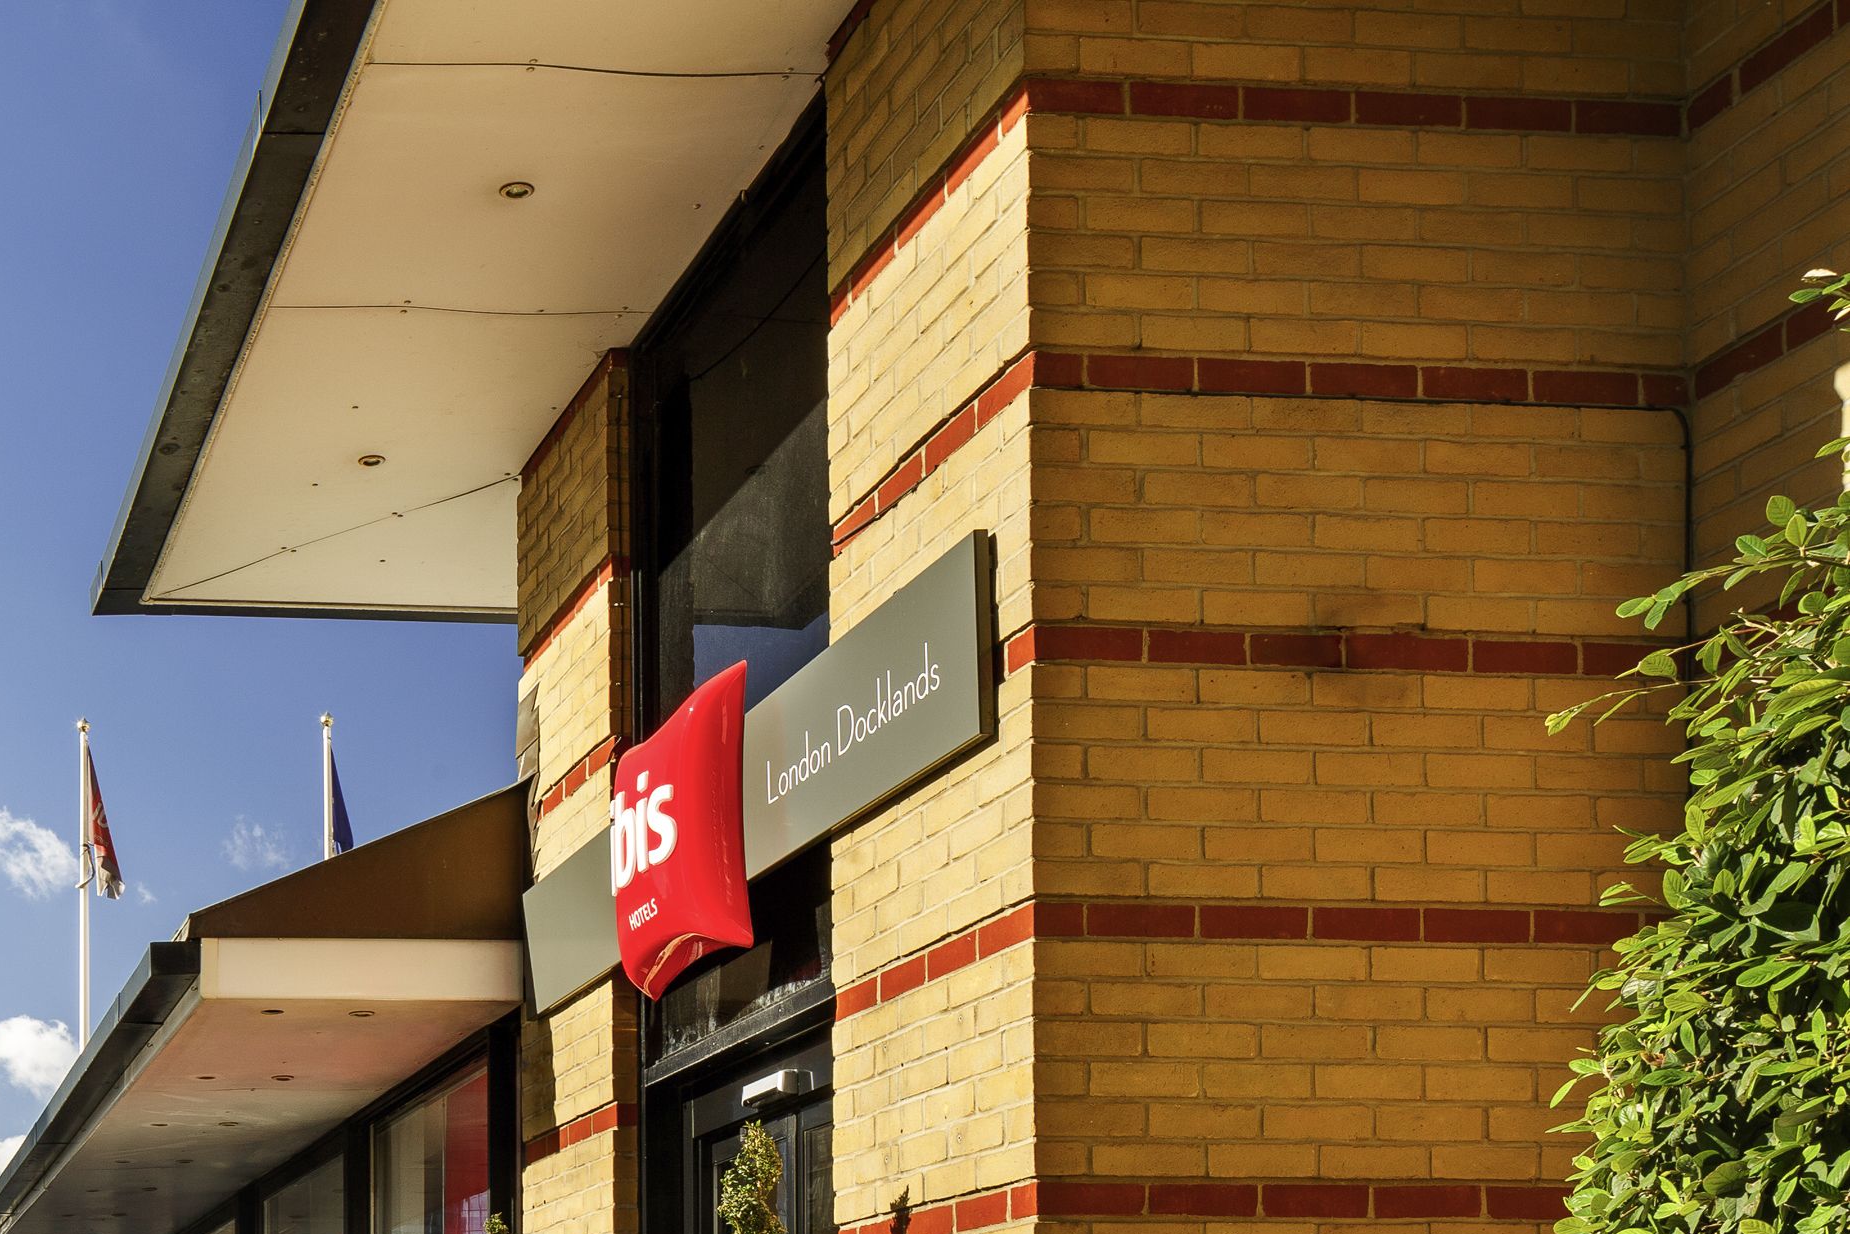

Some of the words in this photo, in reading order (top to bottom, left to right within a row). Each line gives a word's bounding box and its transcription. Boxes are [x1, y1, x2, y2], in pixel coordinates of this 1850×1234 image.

[766, 730, 831, 805] London
[836, 642, 941, 757] Docklands
[629, 898, 658, 931] HOTELS
